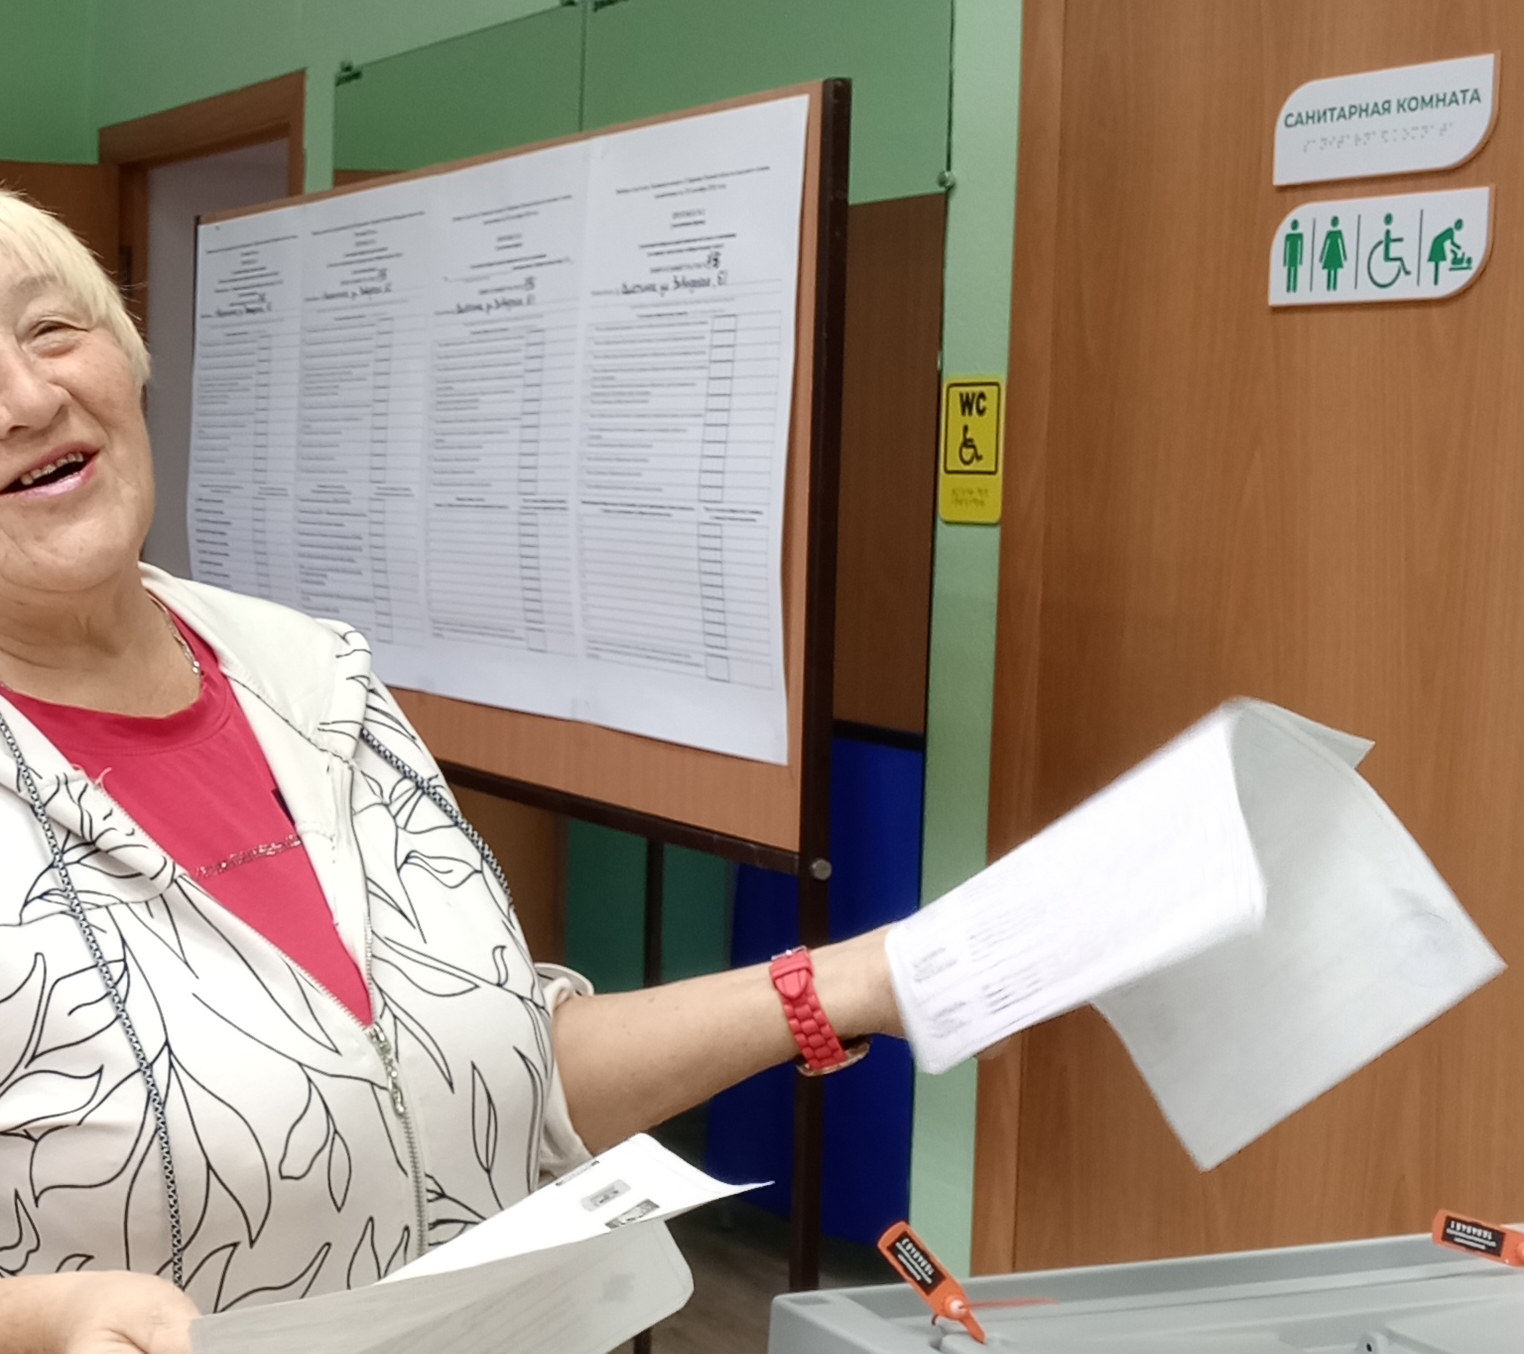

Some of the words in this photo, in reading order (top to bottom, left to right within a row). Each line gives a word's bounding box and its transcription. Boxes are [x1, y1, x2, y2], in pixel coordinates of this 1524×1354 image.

[1284, 99, 1392, 129] САНИТАРНАЯ
[1395, 88, 1481, 115] КОМНАТА
[959, 391, 987, 417] WC
